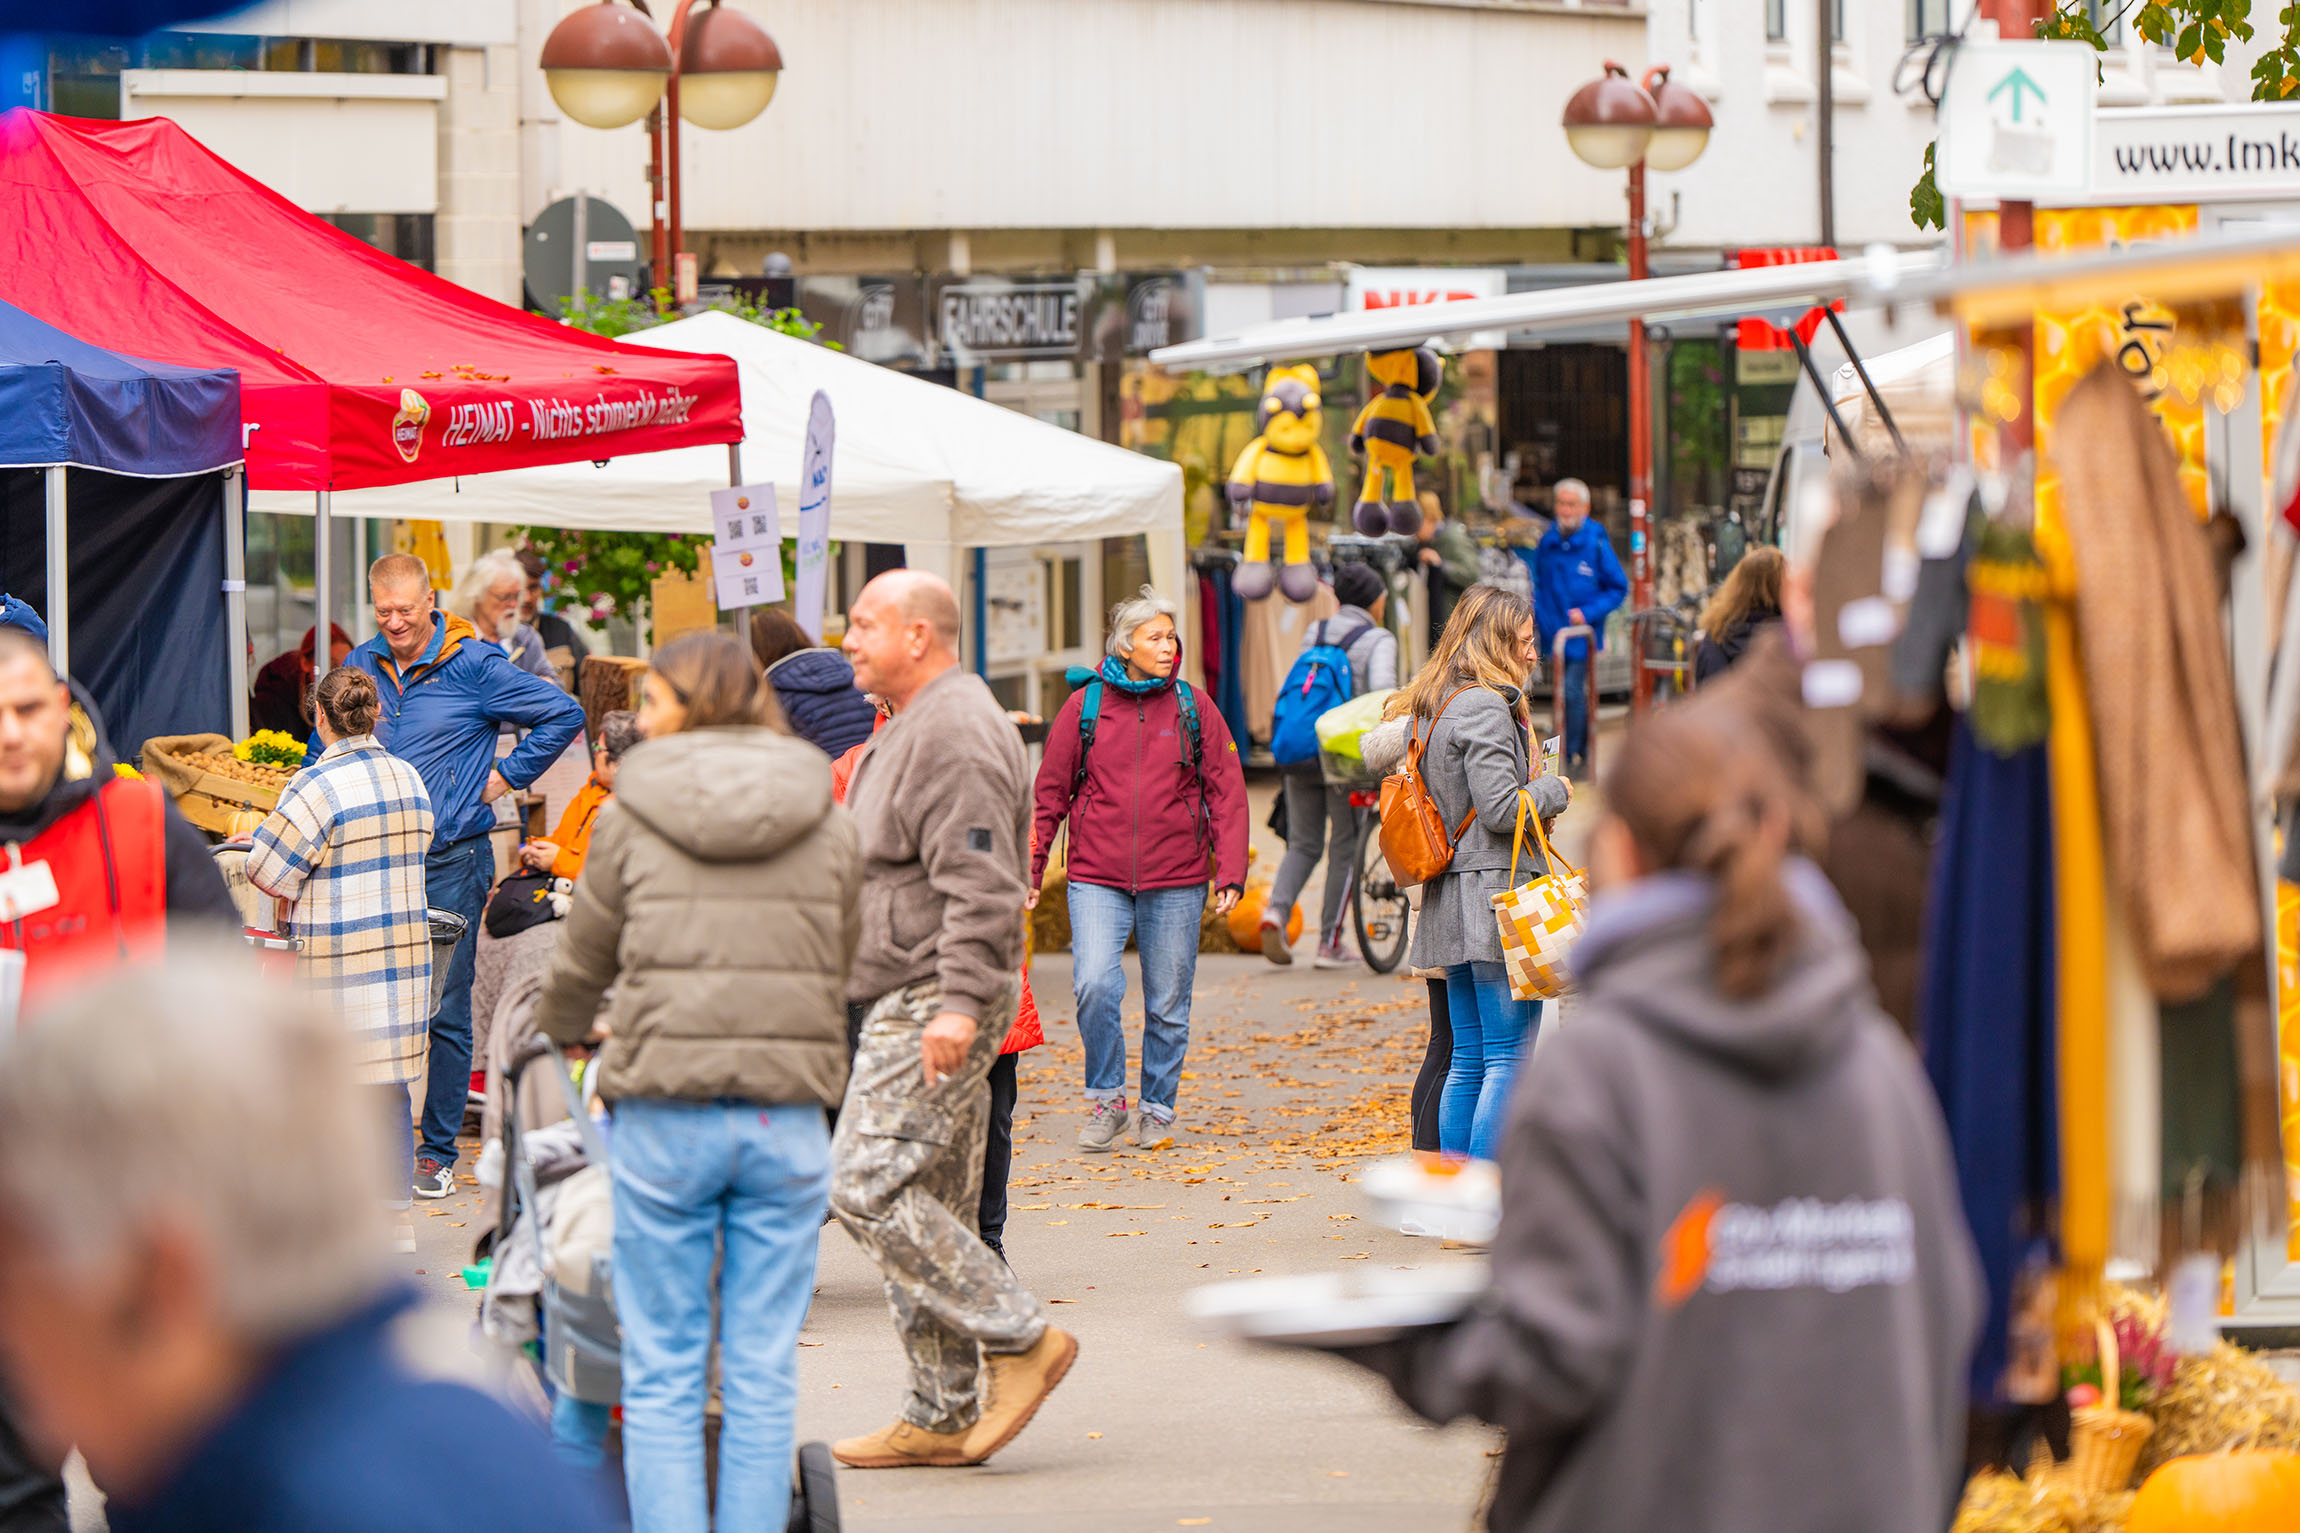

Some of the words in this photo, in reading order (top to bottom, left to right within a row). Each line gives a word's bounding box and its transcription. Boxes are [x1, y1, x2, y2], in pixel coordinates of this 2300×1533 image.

[944, 296, 1077, 343] FAHRSCHULE
[442, 400, 514, 447] HEIMAT
[528, 397, 583, 441] Nichts
[585, 389, 656, 435] schmeckt
